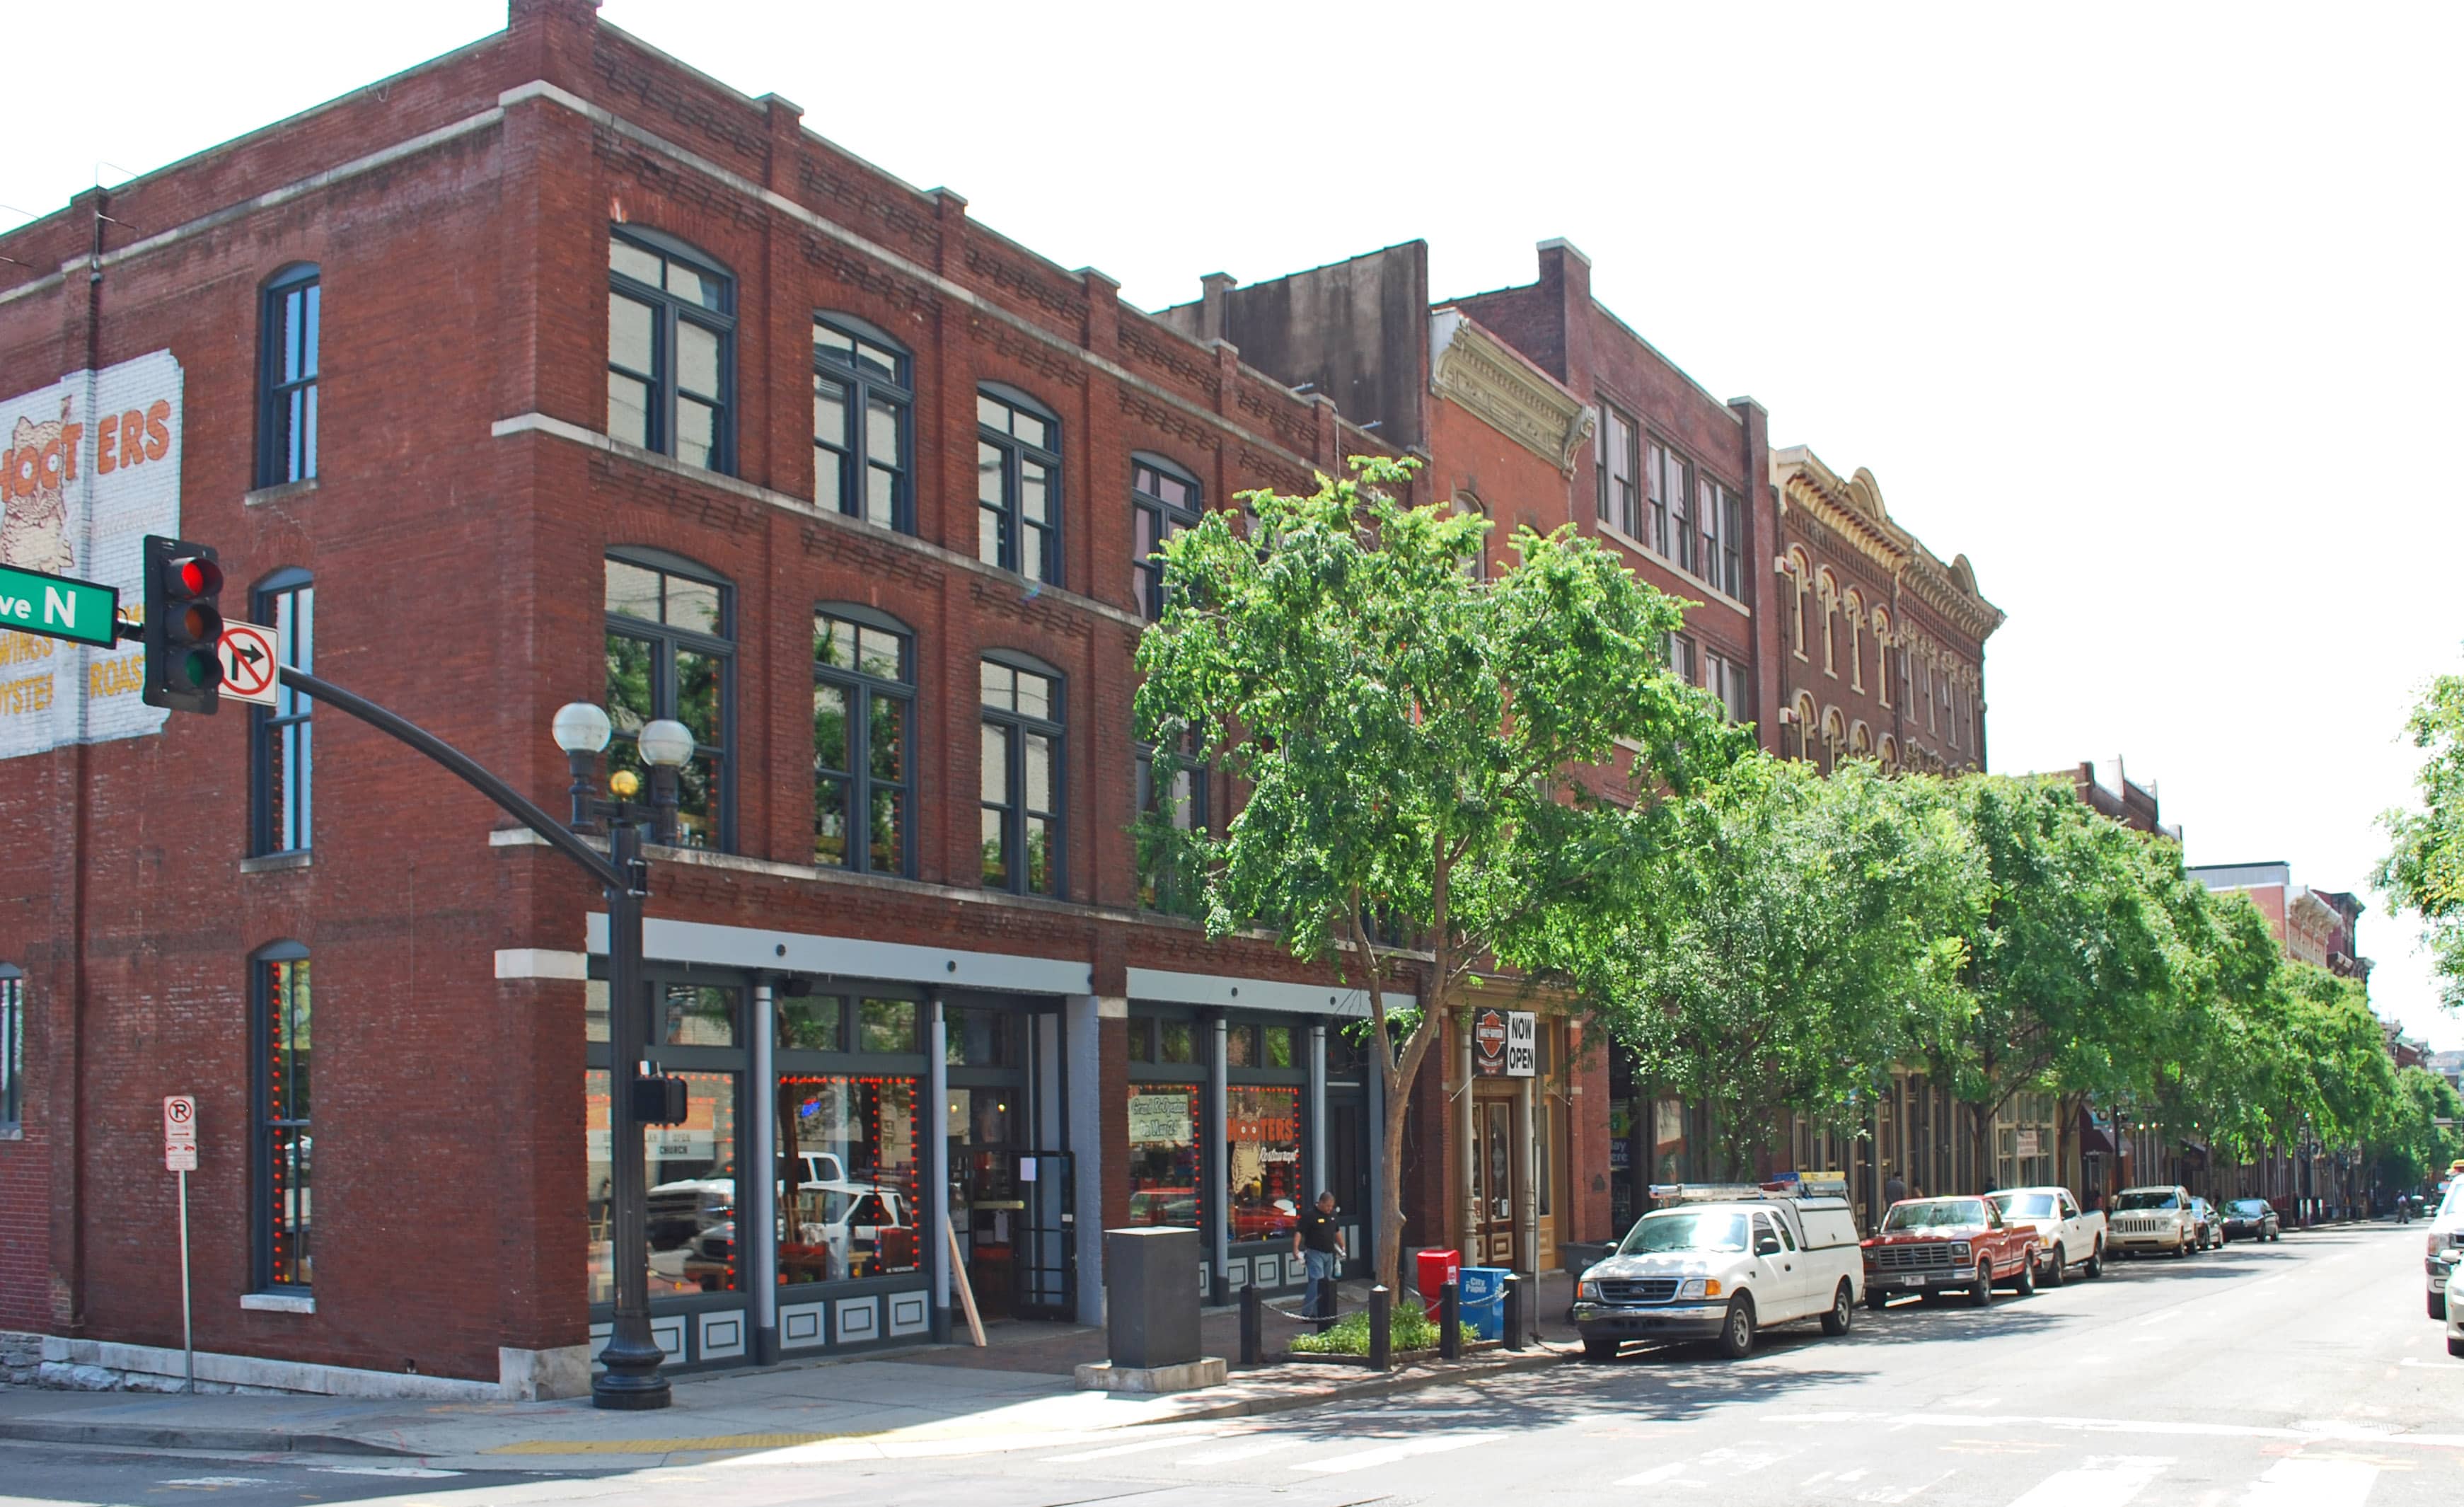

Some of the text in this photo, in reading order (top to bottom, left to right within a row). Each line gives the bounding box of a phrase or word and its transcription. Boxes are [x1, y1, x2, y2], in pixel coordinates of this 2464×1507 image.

[0, 594, 32, 619] ve
[44, 585, 76, 628] N
[0, 654, 145, 716] YSTE ROAS
[1511, 1017, 1532, 1039] NOW
[1509, 1047, 1534, 1069] OPEN
[1226, 1117, 1293, 1143] HOOTERS
